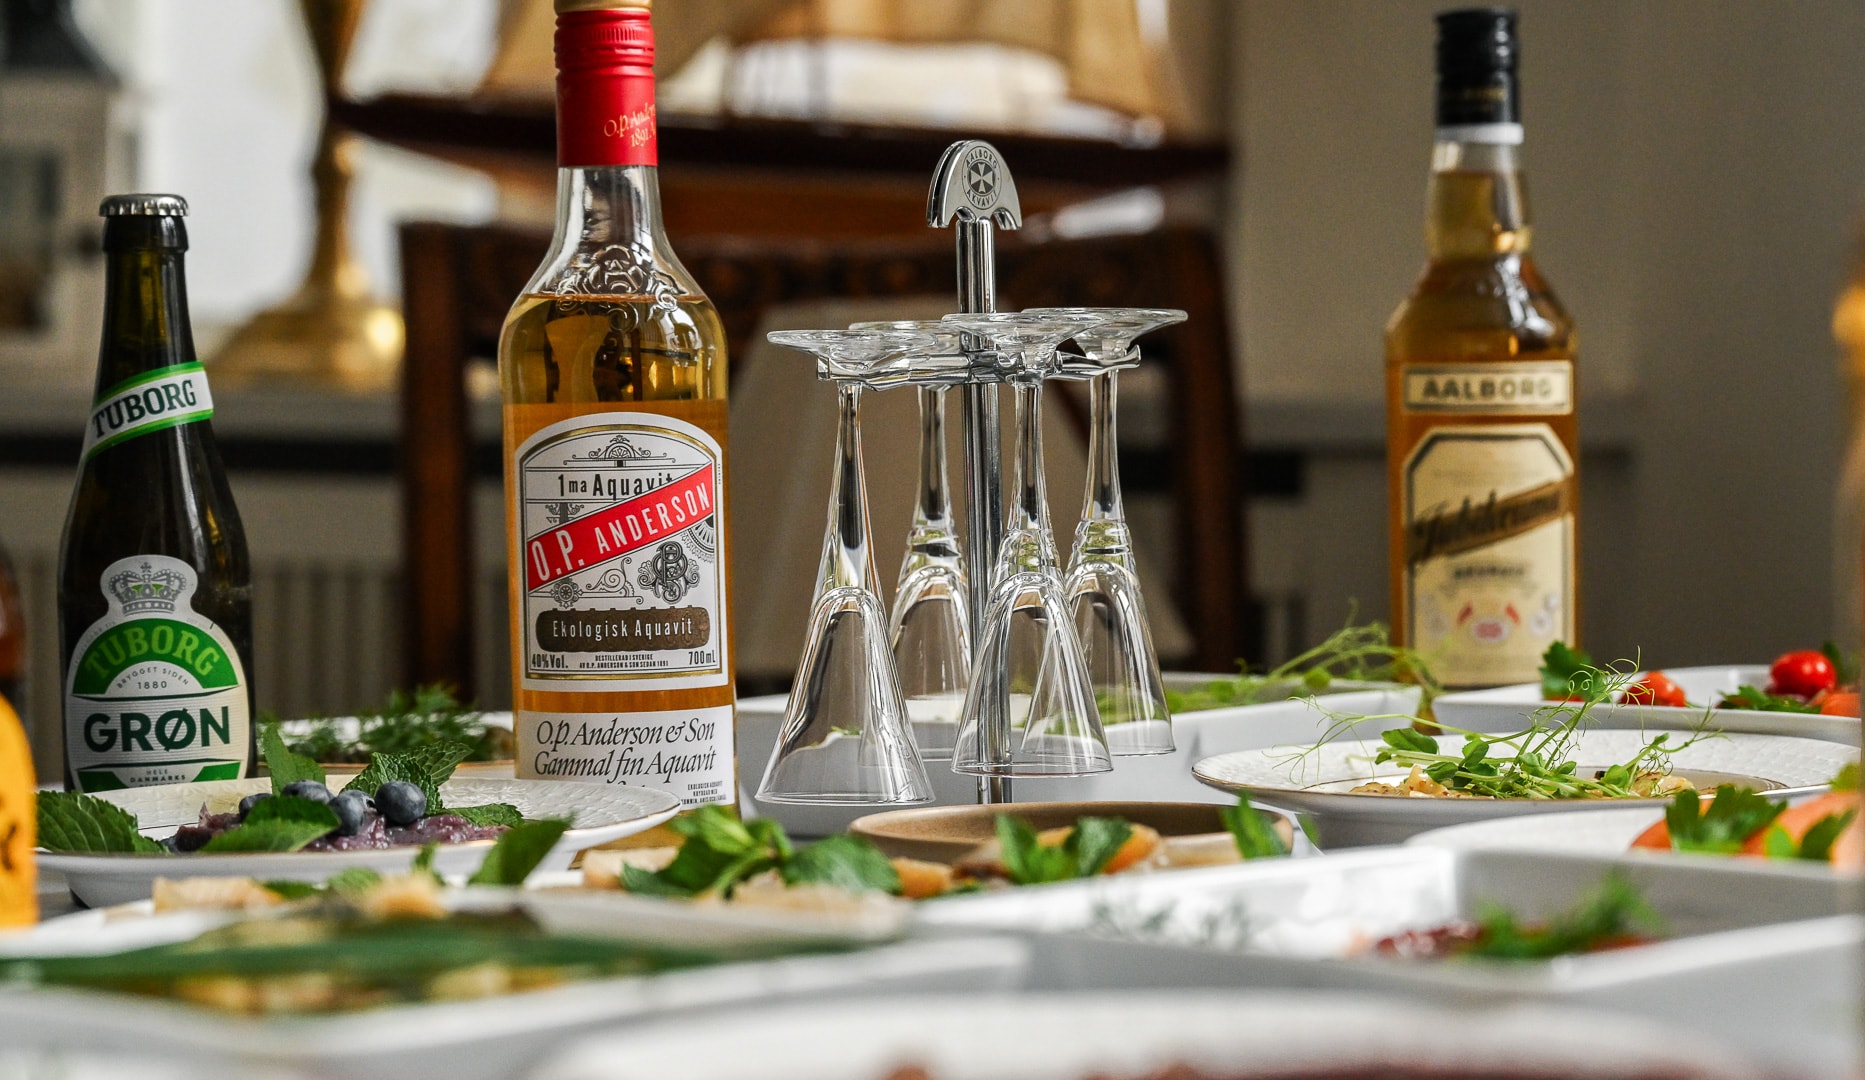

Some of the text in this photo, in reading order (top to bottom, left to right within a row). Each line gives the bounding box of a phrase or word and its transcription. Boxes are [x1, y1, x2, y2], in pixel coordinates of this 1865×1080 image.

[966, 149, 997, 169] AALBORG
[92, 380, 197, 438] TUBORG
[558, 474, 587, 496] 1ma
[531, 530, 584, 581] O.P.
[594, 483, 710, 554] ANDERSON
[553, 617, 693, 641] Ekologisk Aquavit
[84, 625, 220, 678] TUBORG
[117, 667, 189, 688] BRYGGET SIDEN
[138, 681, 167, 689] 1880
[84, 706, 230, 752] GRØN
[570, 717, 662, 746] Anderson
[666, 721, 686, 743] &
[685, 717, 715, 743] Son
[534, 745, 717, 784] Gammal fin Aquavit
[130, 775, 185, 783] DANMARKS
